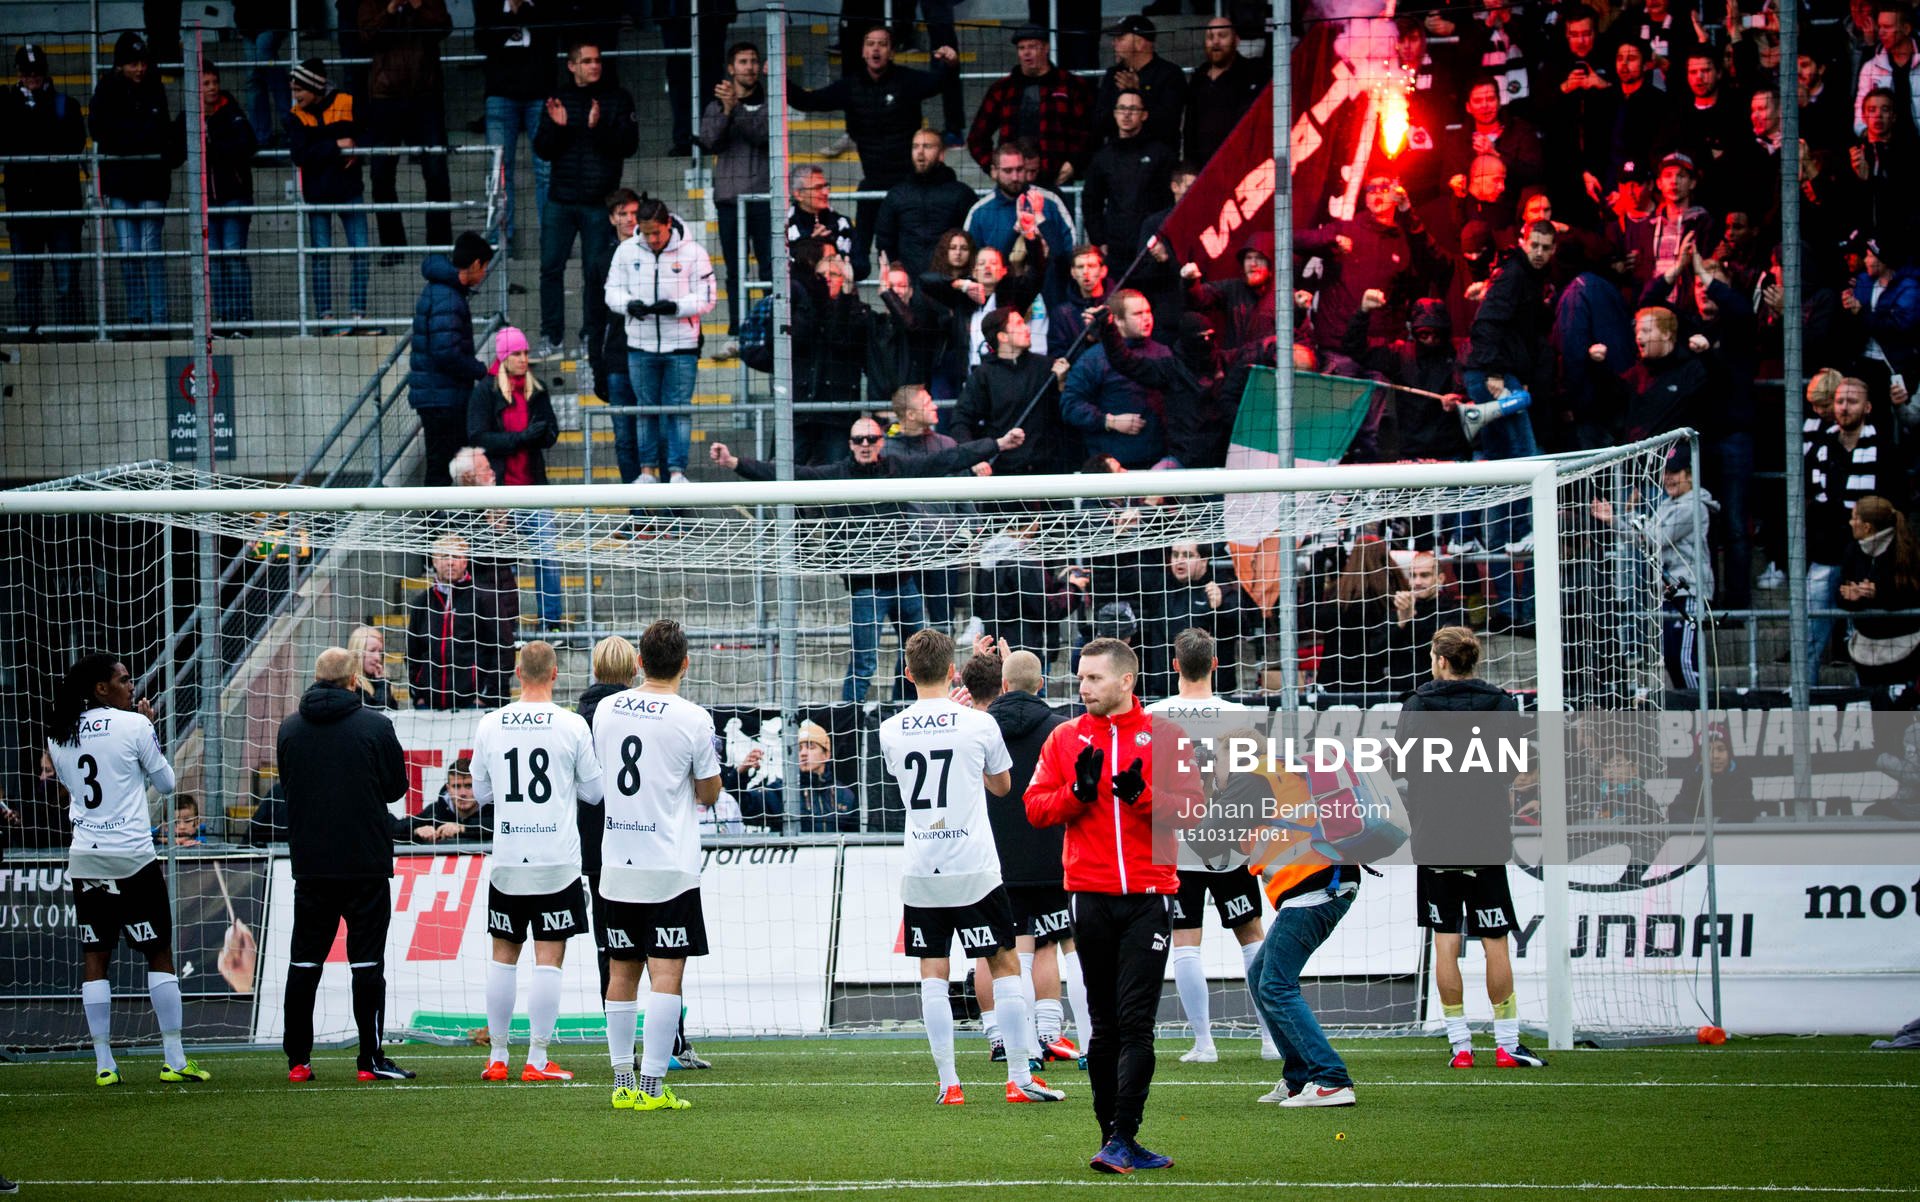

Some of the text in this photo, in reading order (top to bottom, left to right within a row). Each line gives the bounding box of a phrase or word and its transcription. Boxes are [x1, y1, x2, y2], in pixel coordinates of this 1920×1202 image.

[614, 696, 669, 714] EXACT
[1167, 707, 1221, 719] EXACT
[501, 712, 554, 725] EXACT
[902, 712, 958, 730] EXACT
[504, 747, 552, 803] 18
[617, 735, 643, 796] 8
[77, 753, 103, 810] 3
[904, 749, 954, 810] 27
[501, 821, 557, 834] Katrinelund
[606, 816, 656, 832] Katrinelund
[1224, 894, 1254, 920] NA
[1475, 907, 1509, 928] NA
[490, 909, 514, 934] NA
[541, 909, 576, 931] NA
[606, 927, 634, 949] NA
[655, 927, 689, 948] NA
[960, 926, 997, 949] NA
